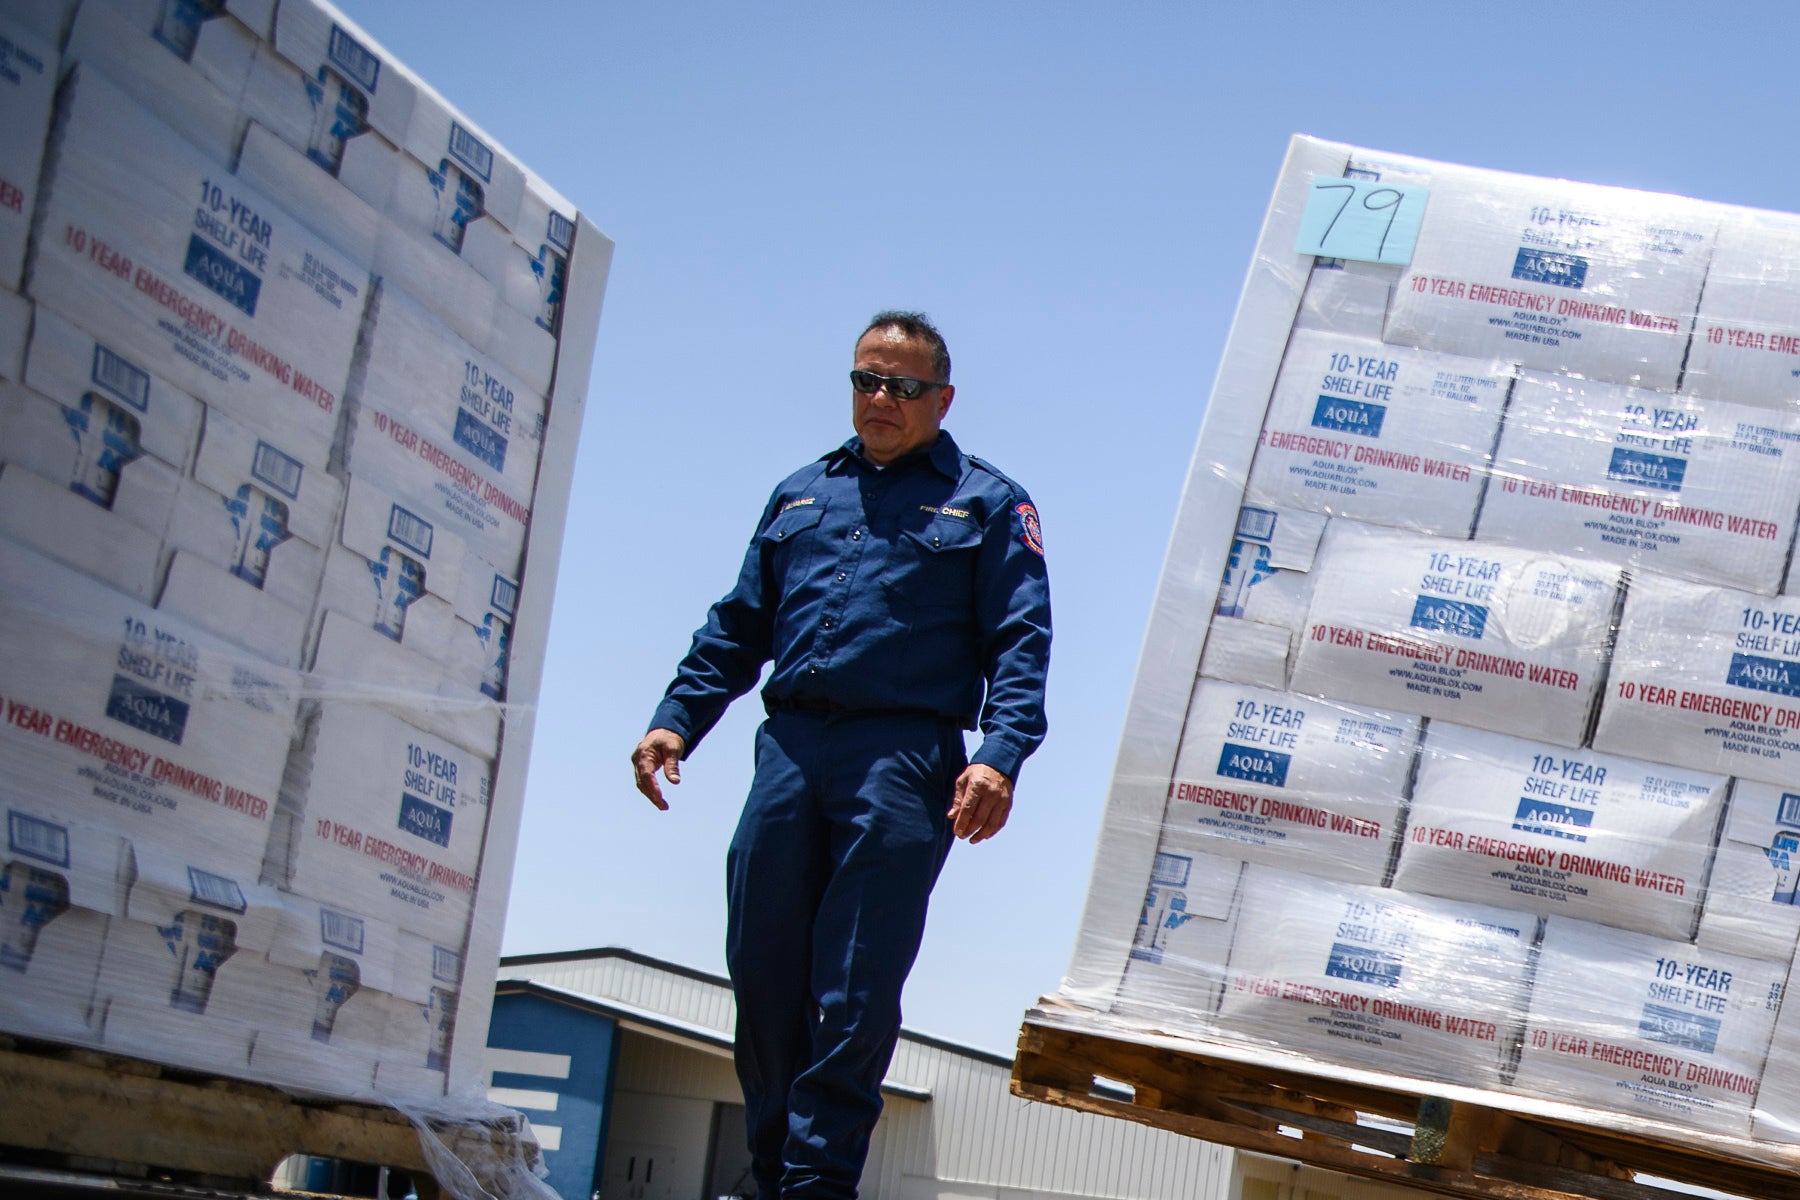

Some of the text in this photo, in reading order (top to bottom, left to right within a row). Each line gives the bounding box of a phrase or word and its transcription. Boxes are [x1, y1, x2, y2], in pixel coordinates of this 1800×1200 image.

[200, 180, 273, 250] 10-YEAR
[1316, 184, 1404, 261] 79
[1410, 277, 1626, 325] 10 YEAR EMERGENCY DRINKING
[86, 238, 334, 414] YEAR EMERGENCY DRINKING WATER
[1707, 328, 1723, 345] 10
[1725, 331, 1765, 350] YEAR
[464, 360, 514, 412] 10-YEAR
[1329, 354, 1399, 380] 10-YEAR
[1322, 376, 1393, 401] SHELF LIFE
[1325, 405, 1369, 425] AQUA
[1271, 432, 1352, 460] EMERGENCY
[1354, 447, 1420, 473] DRINKING
[1423, 459, 1471, 483] WATER
[420, 439, 528, 525] EMERGENCY DRINKING
[941, 507, 970, 519] CHIEF
[1502, 476, 1777, 540] 10 YEAR EMERGENCY DRINKING WATER
[1421, 575, 1495, 601] SHELF LIFE
[1312, 624, 1578, 690] 10 YEAR DRINKING WATER
[1736, 633, 1780, 652] SHELF
[1741, 664, 1789, 684] AQUA
[1235, 700, 1305, 729] 10-YEAR
[1618, 682, 1633, 700] 10
[1636, 685, 1676, 706] YEAR
[1680, 692, 1772, 723] EMERGENCY
[1227, 723, 1299, 749] SHELF LIFE
[7, 705, 268, 821] YEAR EMERGENCY DRINKING WATER
[408, 744, 458, 785] 10-YEAR
[1231, 754, 1274, 775] AQUA
[1531, 754, 1607, 786] 10-YEAR
[404, 772, 456, 808] SHELF LIFE
[1524, 778, 1600, 806] SHELF LIFE
[407, 807, 440, 834] AQUA
[1177, 785, 1259, 813] EMERGENCY
[1261, 799, 1327, 828] DRINKING
[1330, 813, 1381, 839] WATER
[317, 819, 474, 894] 10 YEAR EMERGENCY DRINKING
[1412, 826, 1685, 895] 10 YEAR EMERGENCY DRINKING WATER
[1656, 958, 1733, 992] 10-YEAR
[1283, 983, 1496, 1041] EMERGENCY DRINKING WATER
[1648, 983, 1727, 1014] SHELF LIFE
[1532, 1029, 1757, 1096] 10 YEAR EMERGENCY DRINKING
